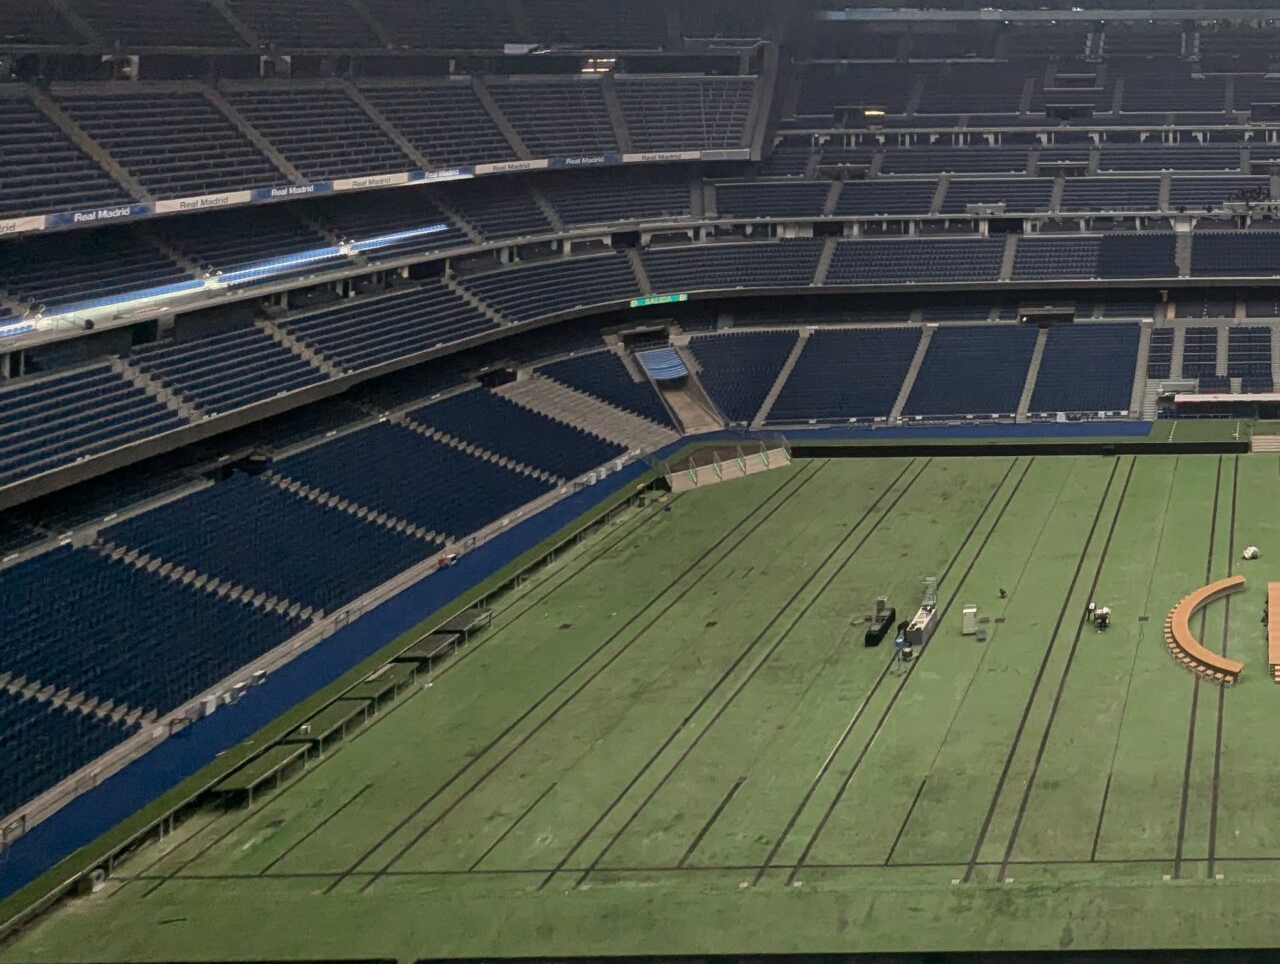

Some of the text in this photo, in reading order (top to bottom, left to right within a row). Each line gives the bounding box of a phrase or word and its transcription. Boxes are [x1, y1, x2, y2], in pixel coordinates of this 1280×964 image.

[352, 176, 391, 188] Real Madrid
[271, 184, 314, 197] Real Madrid
[179, 196, 229, 210] Real Madrid
[74, 207, 131, 223] Real Madrid
